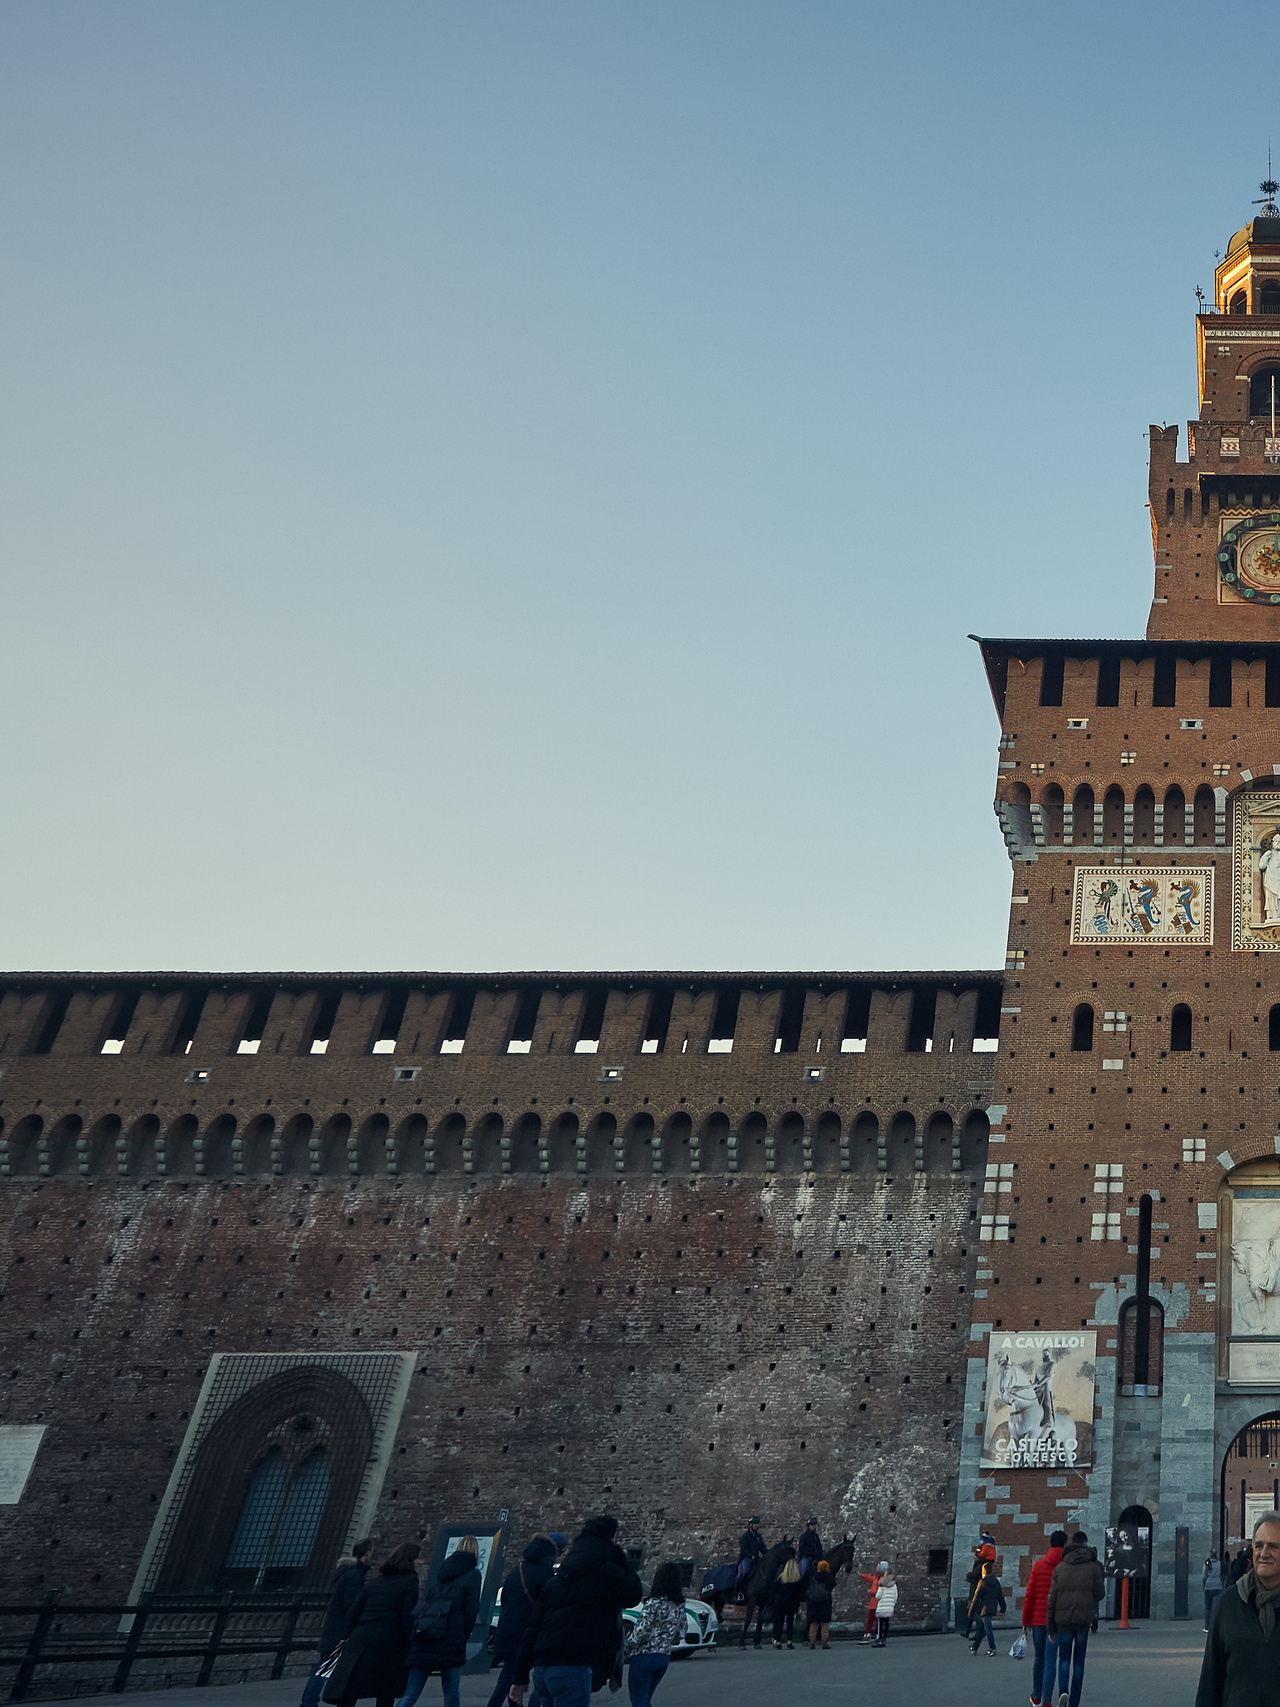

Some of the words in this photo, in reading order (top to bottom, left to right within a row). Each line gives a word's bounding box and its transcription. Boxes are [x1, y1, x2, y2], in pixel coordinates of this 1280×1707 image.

[1002, 1338, 1012, 1348] A
[1015, 1336, 1085, 1348] CAVALLO!
[995, 1439, 1078, 1452] CASTELLO
[995, 1452, 1077, 1462] SFORZESCO
